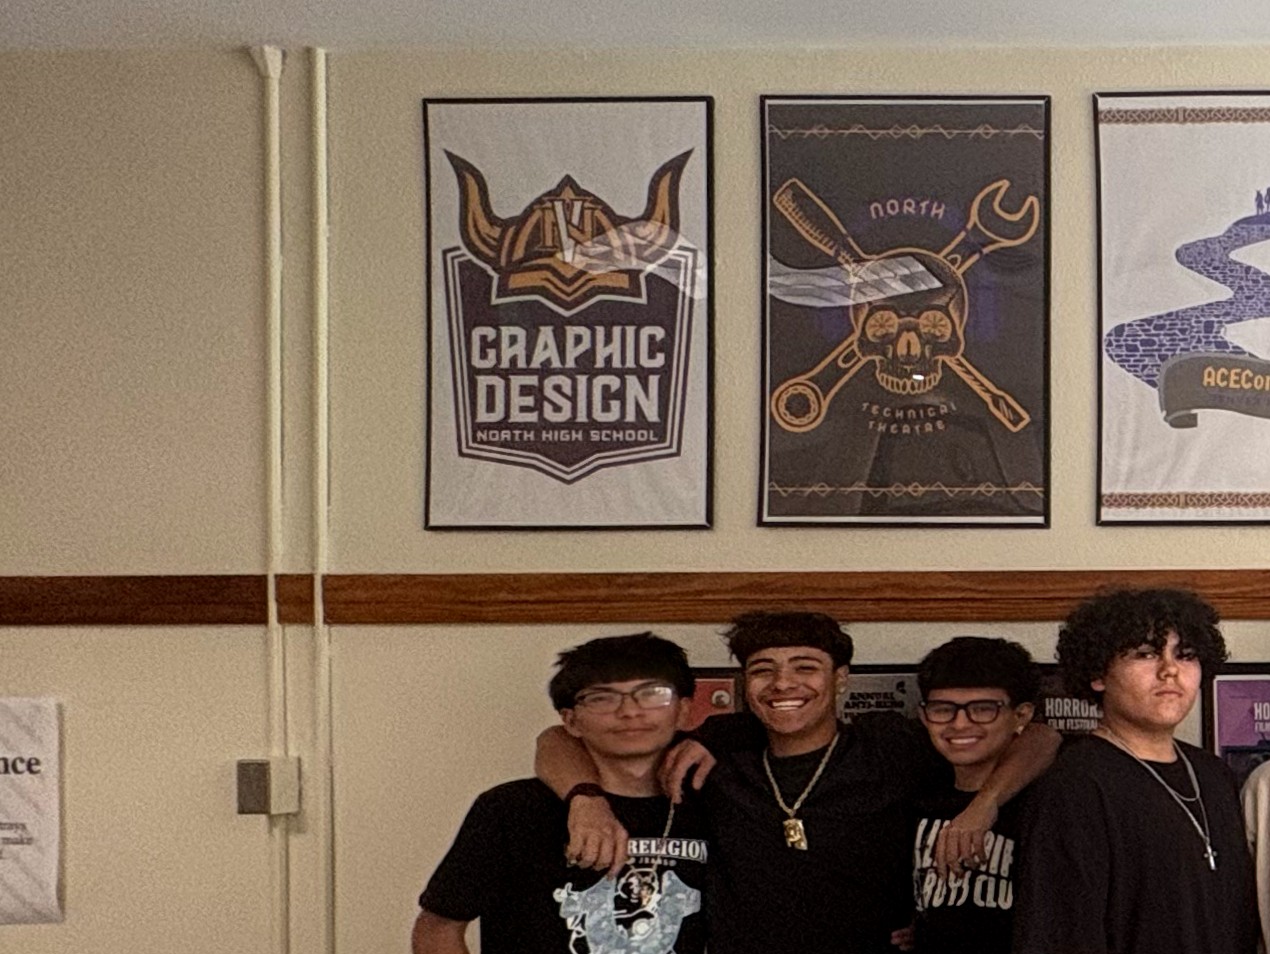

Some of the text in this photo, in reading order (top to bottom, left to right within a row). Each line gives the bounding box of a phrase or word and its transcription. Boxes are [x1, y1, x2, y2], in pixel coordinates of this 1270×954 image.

[870, 198, 946, 220] NORTH
[471, 326, 666, 370] GRAPHIC
[475, 374, 661, 424] DESIGN
[476, 429, 658, 442] NORTH HIGH SCHOOL
[868, 420, 945, 434] THEATRE
[973, 874, 1014, 910] CLU
